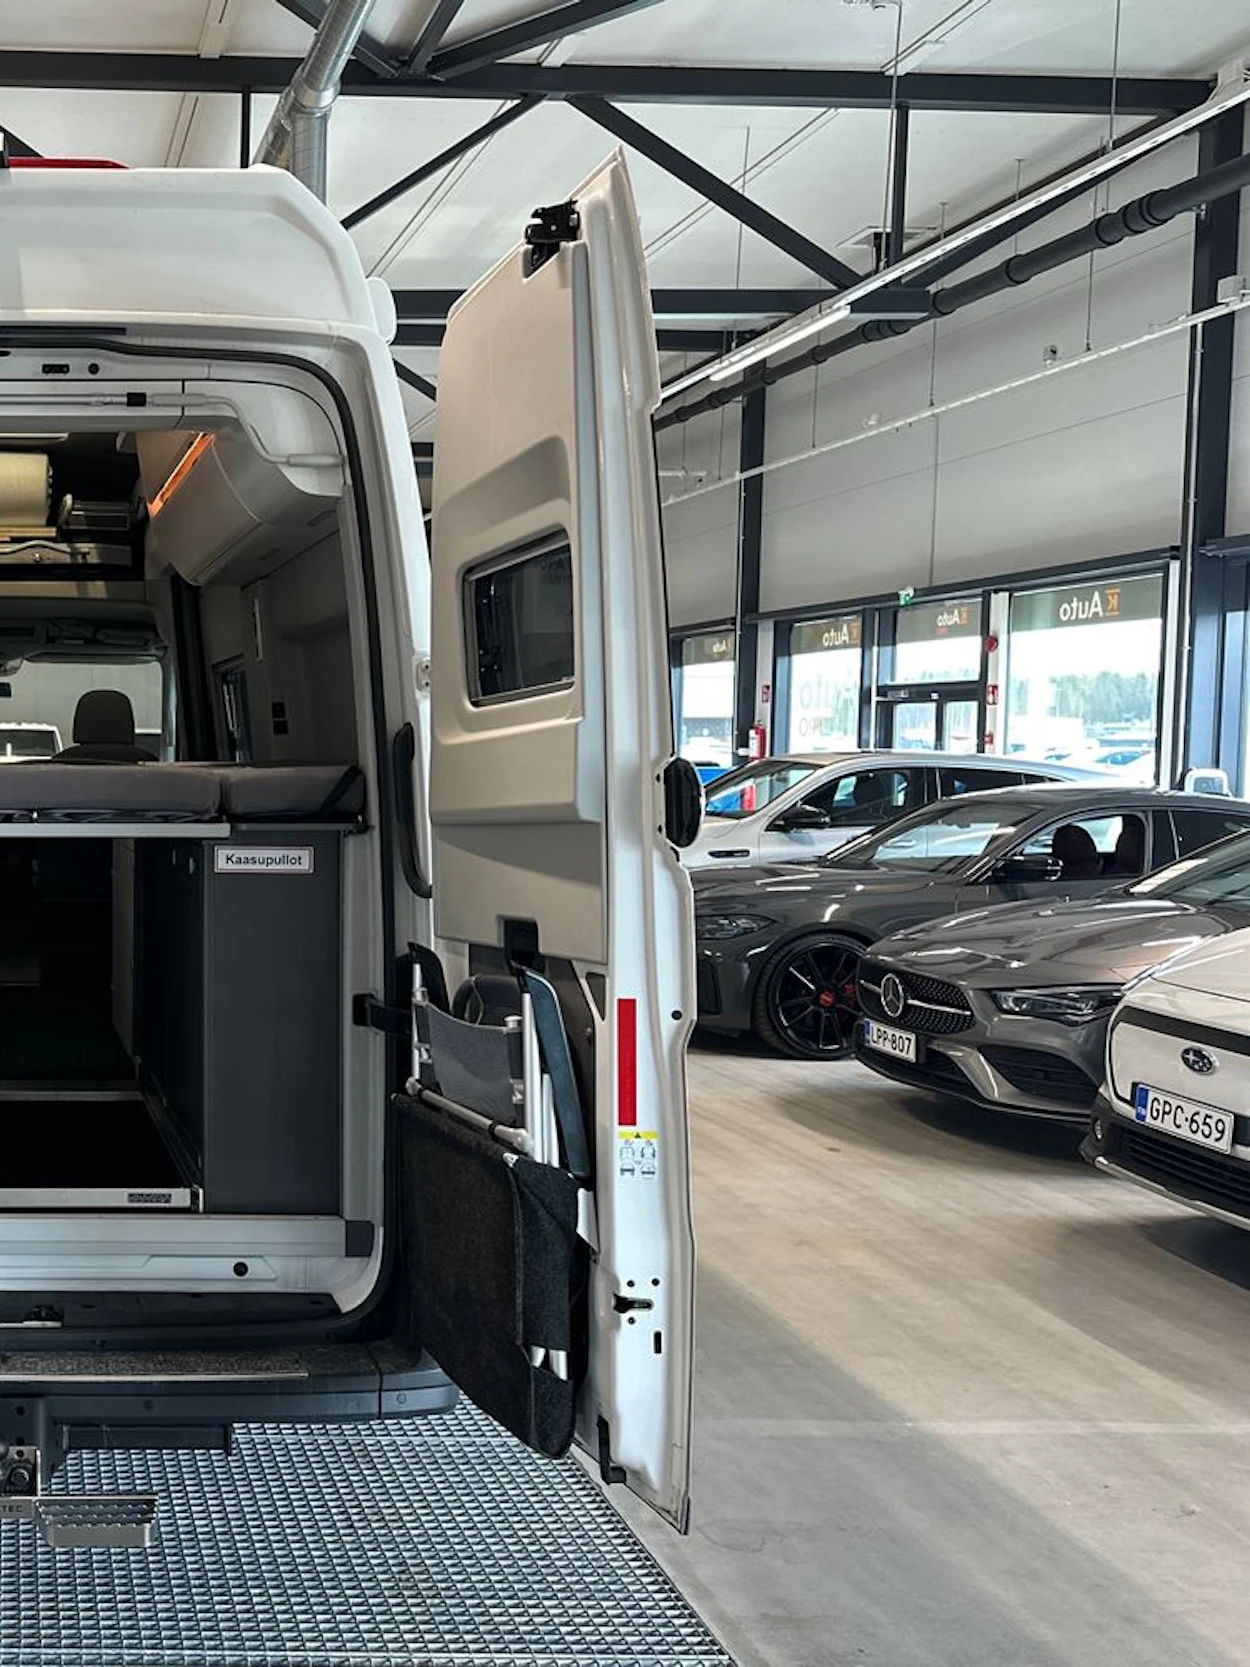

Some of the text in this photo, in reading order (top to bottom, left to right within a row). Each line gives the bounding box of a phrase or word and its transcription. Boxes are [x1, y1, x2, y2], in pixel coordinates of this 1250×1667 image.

[226, 853, 302, 867] Kaasupullot
[871, 1026, 912, 1055] LPP-807
[1150, 1097, 1225, 1142] GPC-659
